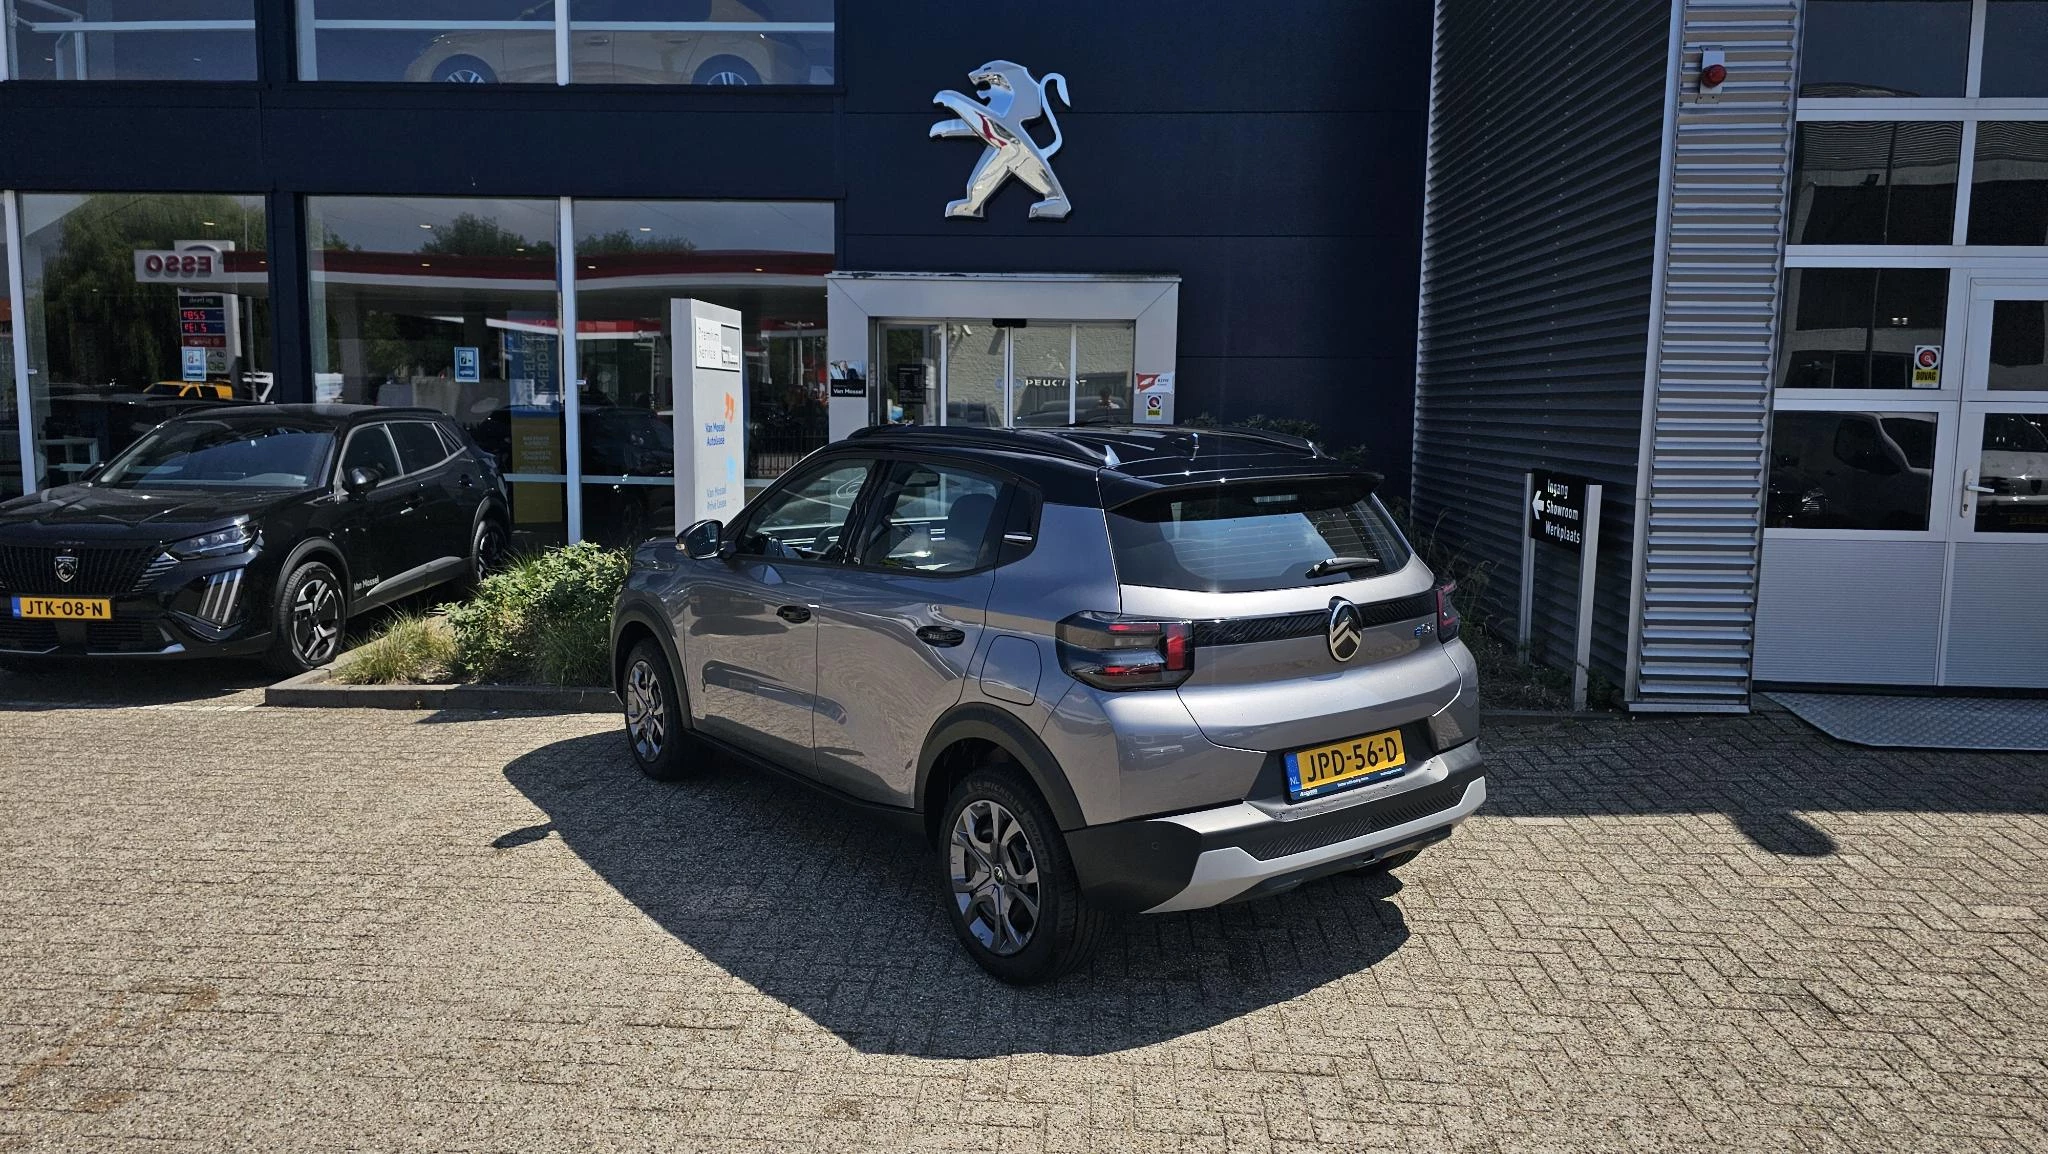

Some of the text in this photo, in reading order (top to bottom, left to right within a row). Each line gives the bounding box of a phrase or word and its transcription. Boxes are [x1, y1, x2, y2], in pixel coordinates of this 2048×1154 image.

[1547, 479, 1569, 500] Ingang
[1546, 500, 1579, 521] Showroom
[1545, 520, 1581, 544] Werkplaats
[26, 600, 103, 617] JTK-08-N
[1289, 776, 1300, 786] NL
[1307, 736, 1398, 783] JPD-56-D
